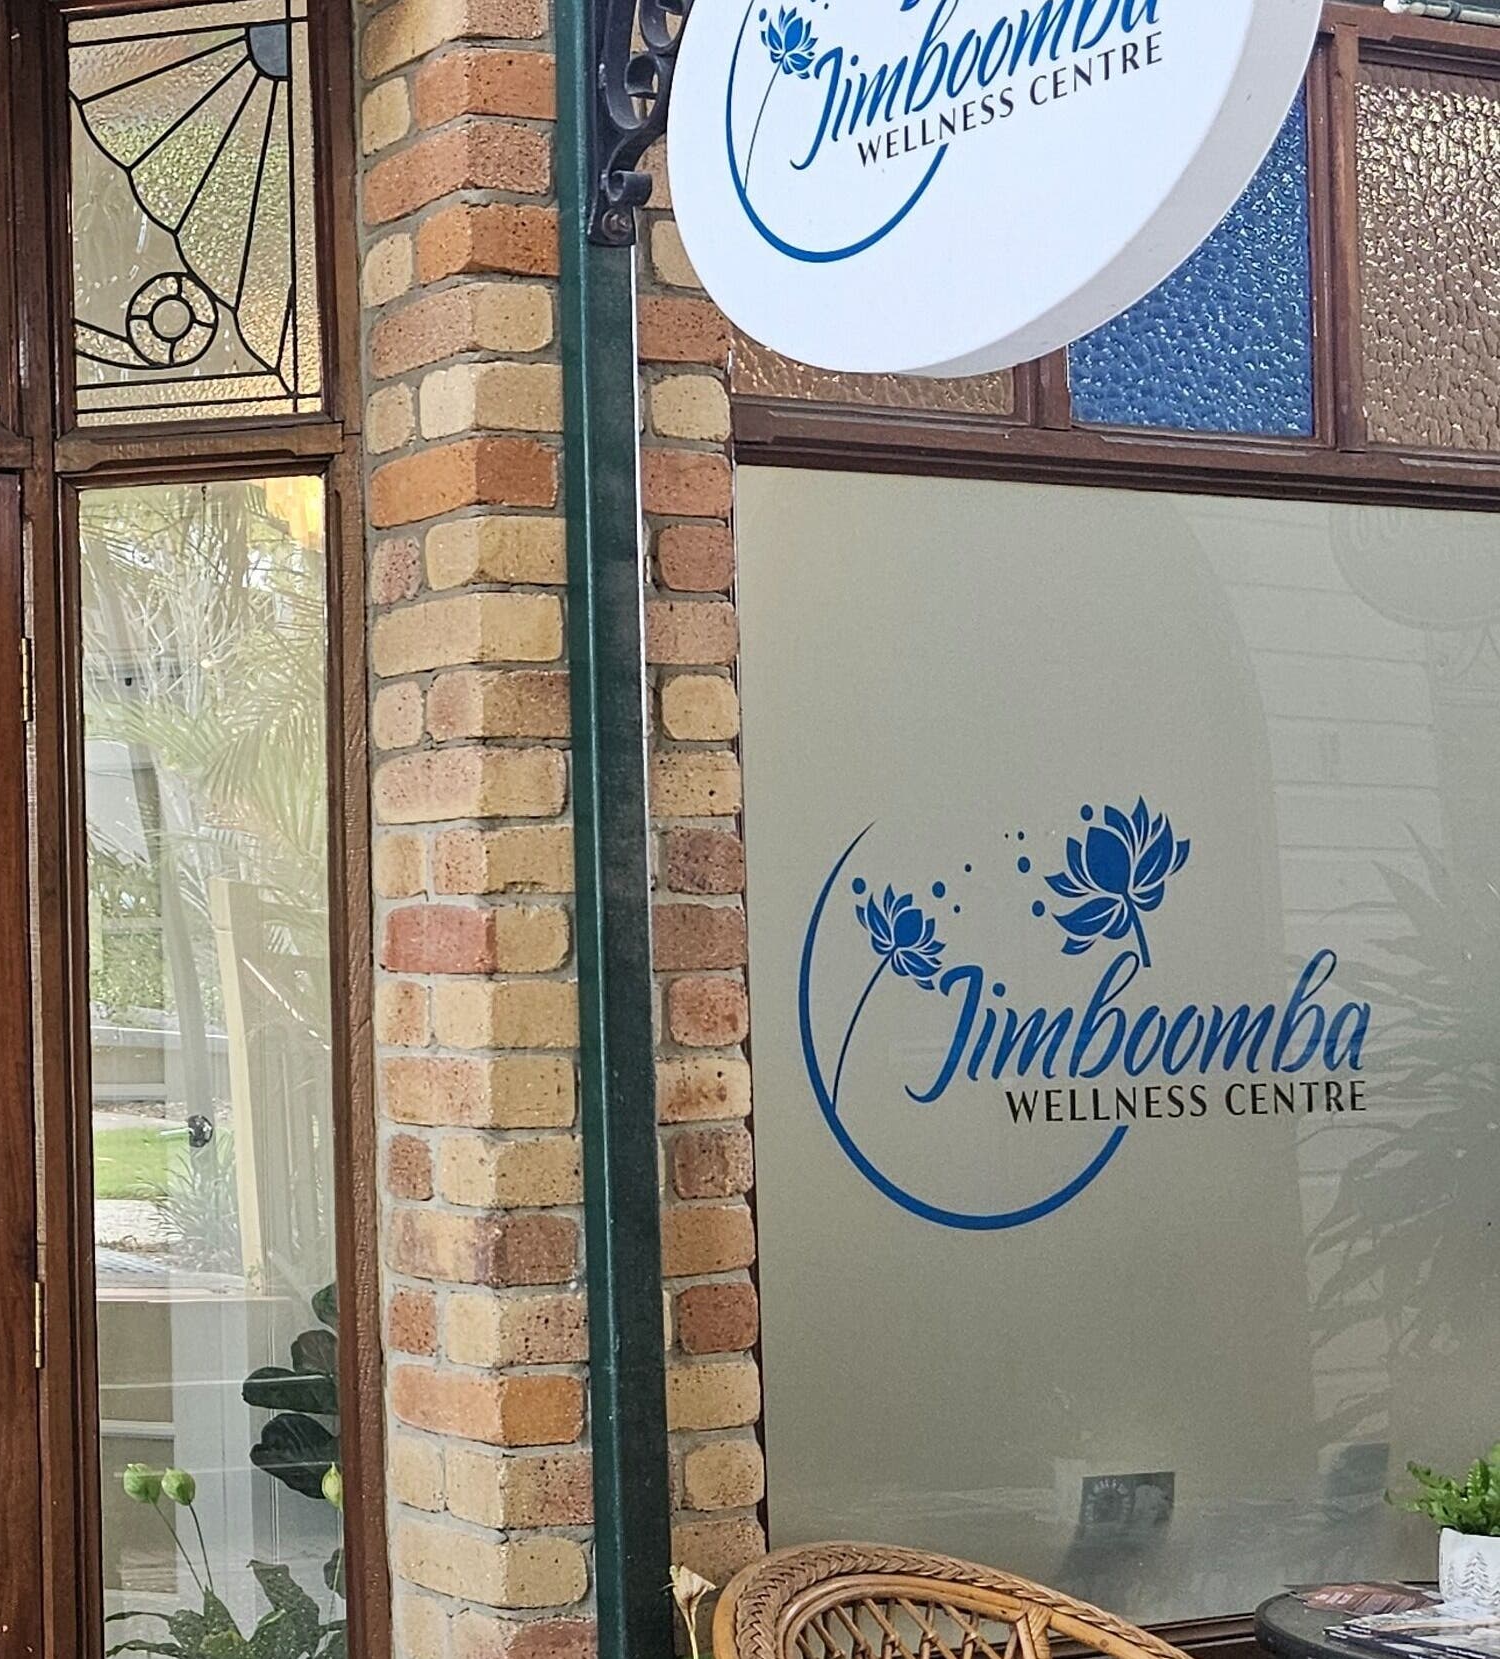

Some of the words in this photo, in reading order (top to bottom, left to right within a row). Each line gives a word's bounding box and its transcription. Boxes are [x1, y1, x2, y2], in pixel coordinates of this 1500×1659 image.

[857, 87, 1015, 168] WELLNESS
[1029, 30, 1164, 106] CENTRE
[904, 948, 1371, 1103] Jimboomba
[1005, 1084, 1207, 1124] WELLNESS
[1224, 1080, 1367, 1116] CENTRE
